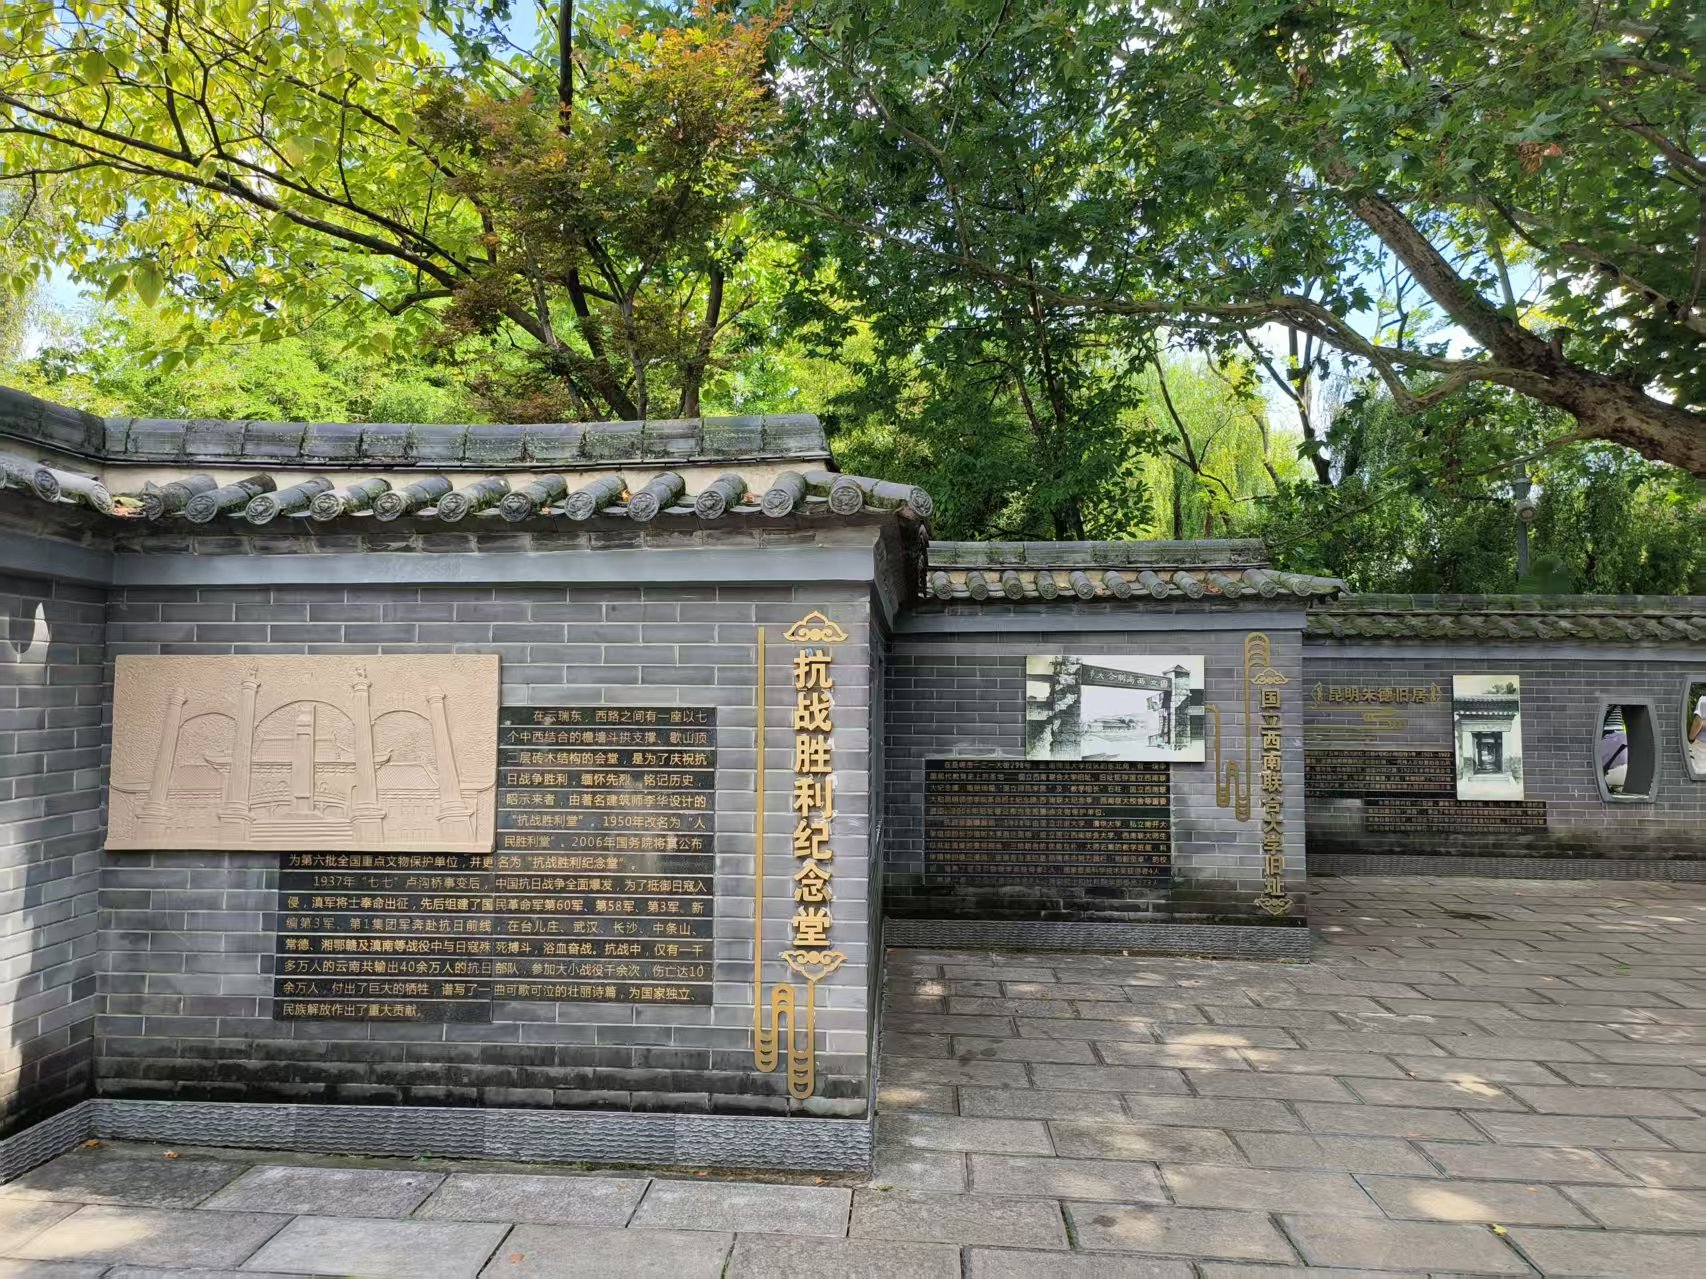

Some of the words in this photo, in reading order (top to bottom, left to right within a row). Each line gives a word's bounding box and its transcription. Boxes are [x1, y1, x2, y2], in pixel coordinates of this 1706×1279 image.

[792, 650, 834, 947] 抗战胜利纪念堂
[1260, 688, 1286, 898] 国立西南联合大学旧址
[1328, 687, 1427, 704] 昆明朱德旧居
